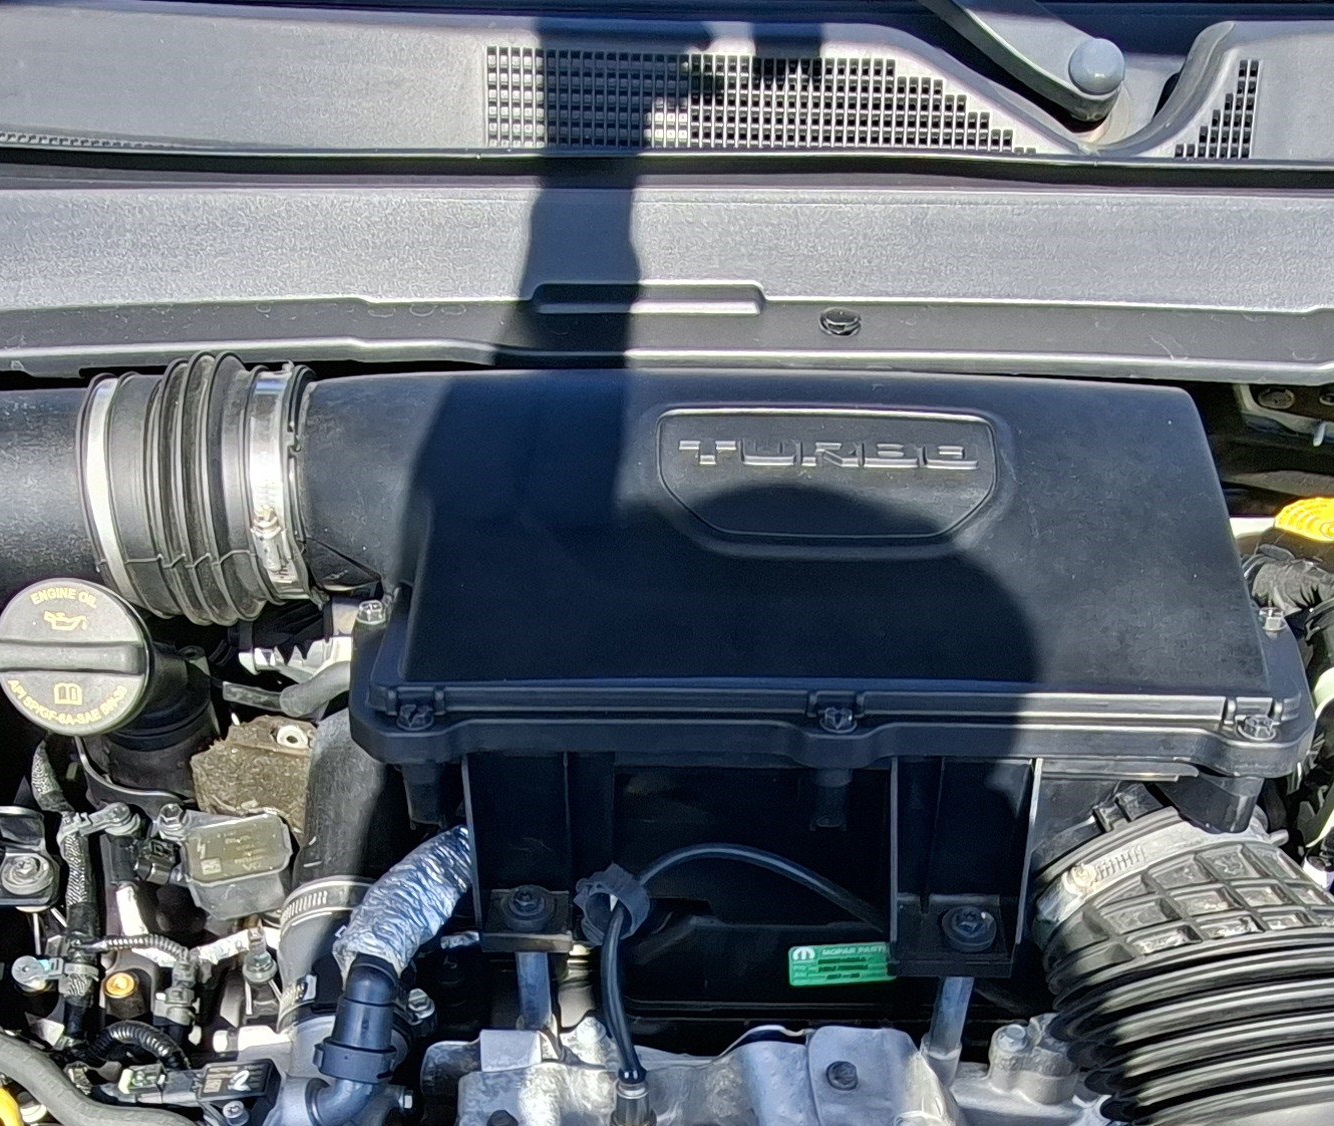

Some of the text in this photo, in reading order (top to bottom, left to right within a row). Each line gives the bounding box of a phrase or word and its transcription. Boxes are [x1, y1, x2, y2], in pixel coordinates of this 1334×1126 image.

[677, 438, 979, 470] TURBO
[30, 587, 97, 609] ENGINE OIL
[7, 679, 26, 700] API
